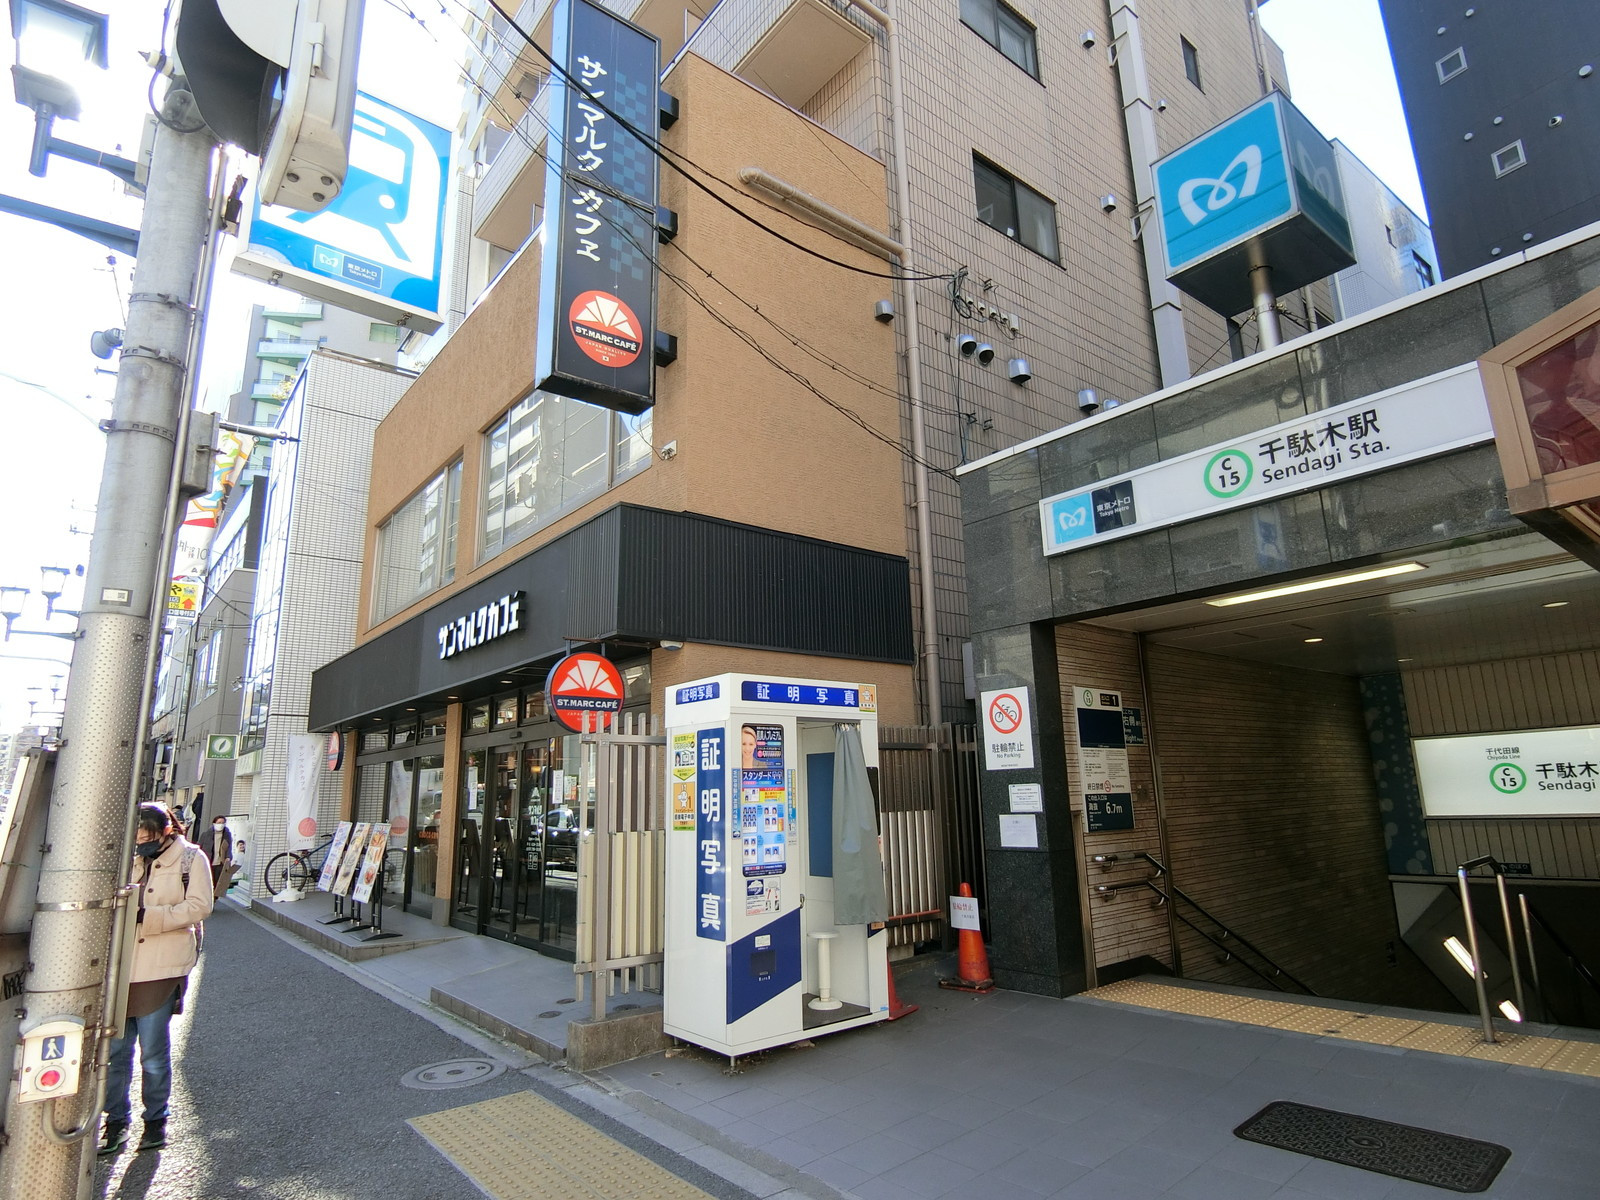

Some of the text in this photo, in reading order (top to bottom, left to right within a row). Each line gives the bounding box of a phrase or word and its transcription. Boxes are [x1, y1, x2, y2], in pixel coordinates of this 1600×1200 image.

[575, 325, 637, 352] ST.MARC CAFÉ
[1259, 409, 1381, 465] 千駄木駅
[1221, 457, 1232, 472] C
[1262, 440, 1391, 485] Sendagi Sta.
[1219, 470, 1241, 489] 15
[1096, 496, 1131, 513] 東京メトロ
[1099, 505, 1130, 518] Tokyo Metro
[438, 590, 519, 660] サンマルクカフェ
[682, 684, 713, 703] 証明写真
[757, 683, 855, 706] 証明写真
[557, 697, 618, 709] ST.MARC CAFÉ
[991, 741, 1024, 753] 駐輪禁止
[1485, 746, 1520, 755] 千代田線
[743, 771, 772, 781] スタンダード
[1502, 767, 1511, 777] C
[1501, 777, 1517, 787] 15
[1538, 779, 1596, 792] Sendagi
[1105, 801, 1123, 814] 6.7m
[701, 737, 721, 931] 証明写真
